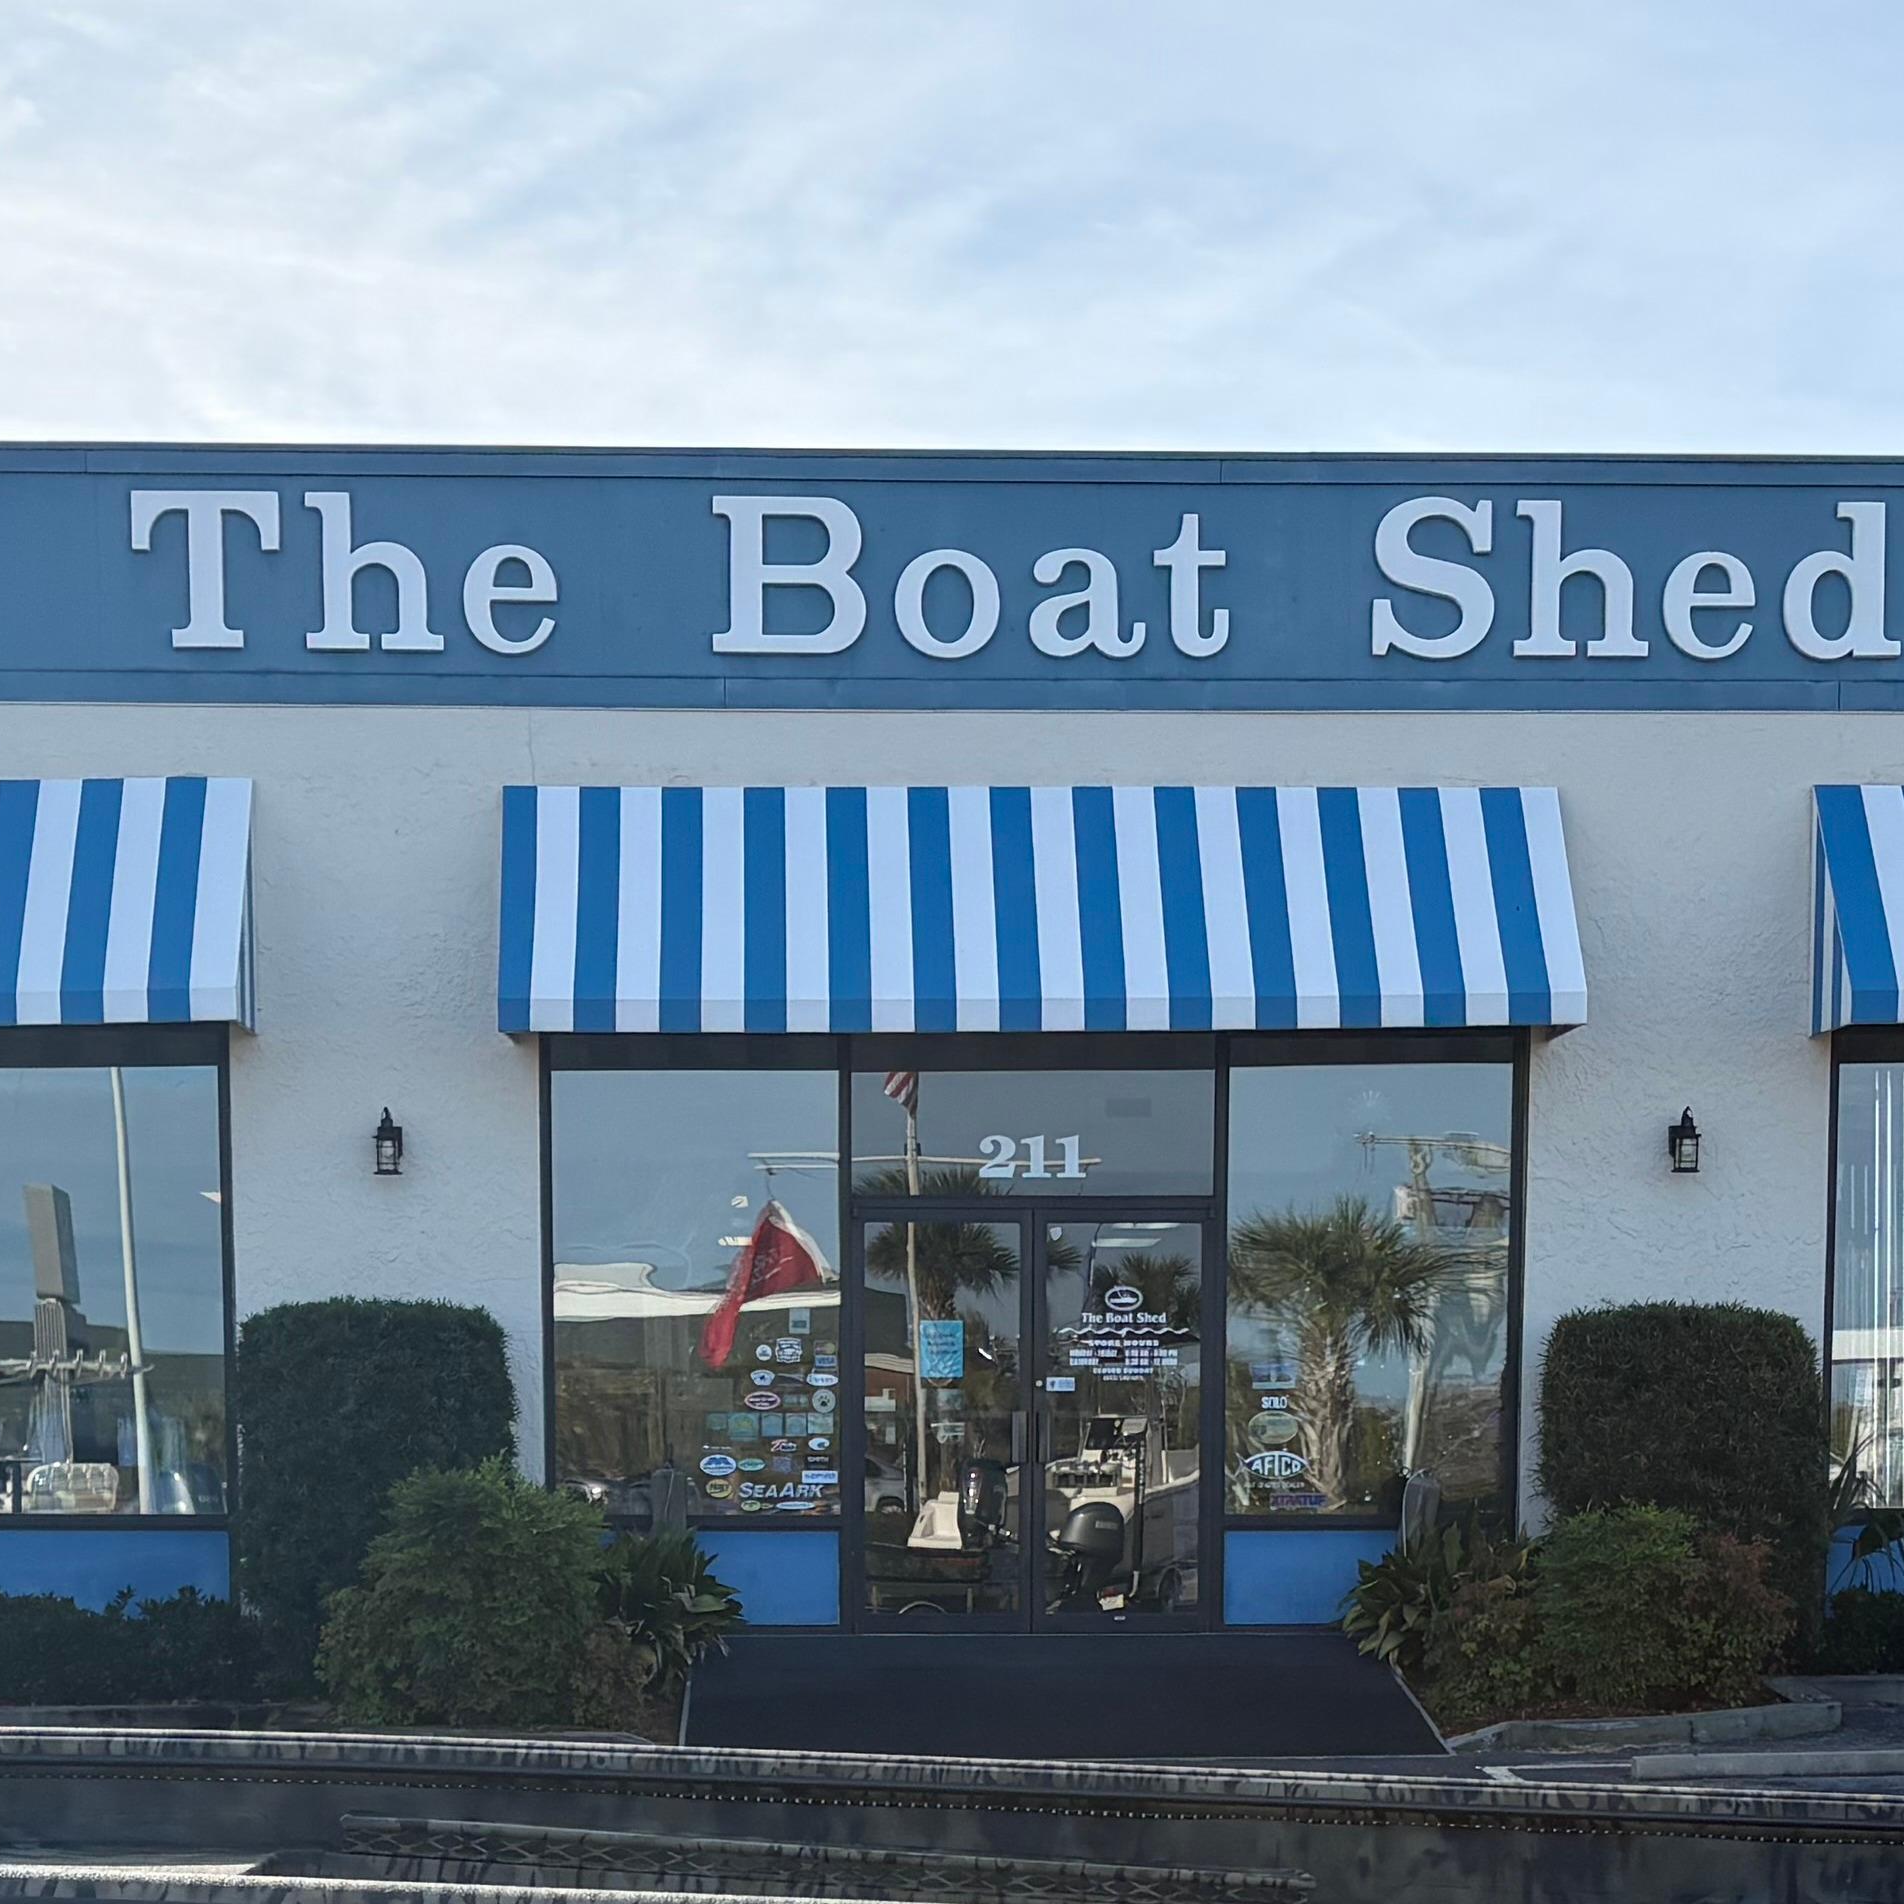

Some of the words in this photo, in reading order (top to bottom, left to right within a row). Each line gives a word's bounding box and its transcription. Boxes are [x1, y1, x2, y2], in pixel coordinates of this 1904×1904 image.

[129, 488, 560, 656] The
[711, 493, 1231, 659] Boat
[1371, 496, 1902, 660] Shed
[978, 1134, 1087, 1178] 211
[1081, 1312, 1103, 1323] The
[1106, 1312, 1133, 1323] Boat
[1136, 1312, 1167, 1323] Shed
[1261, 1396, 1288, 1409] SOLO
[1251, 1453, 1302, 1477] AFTCO
